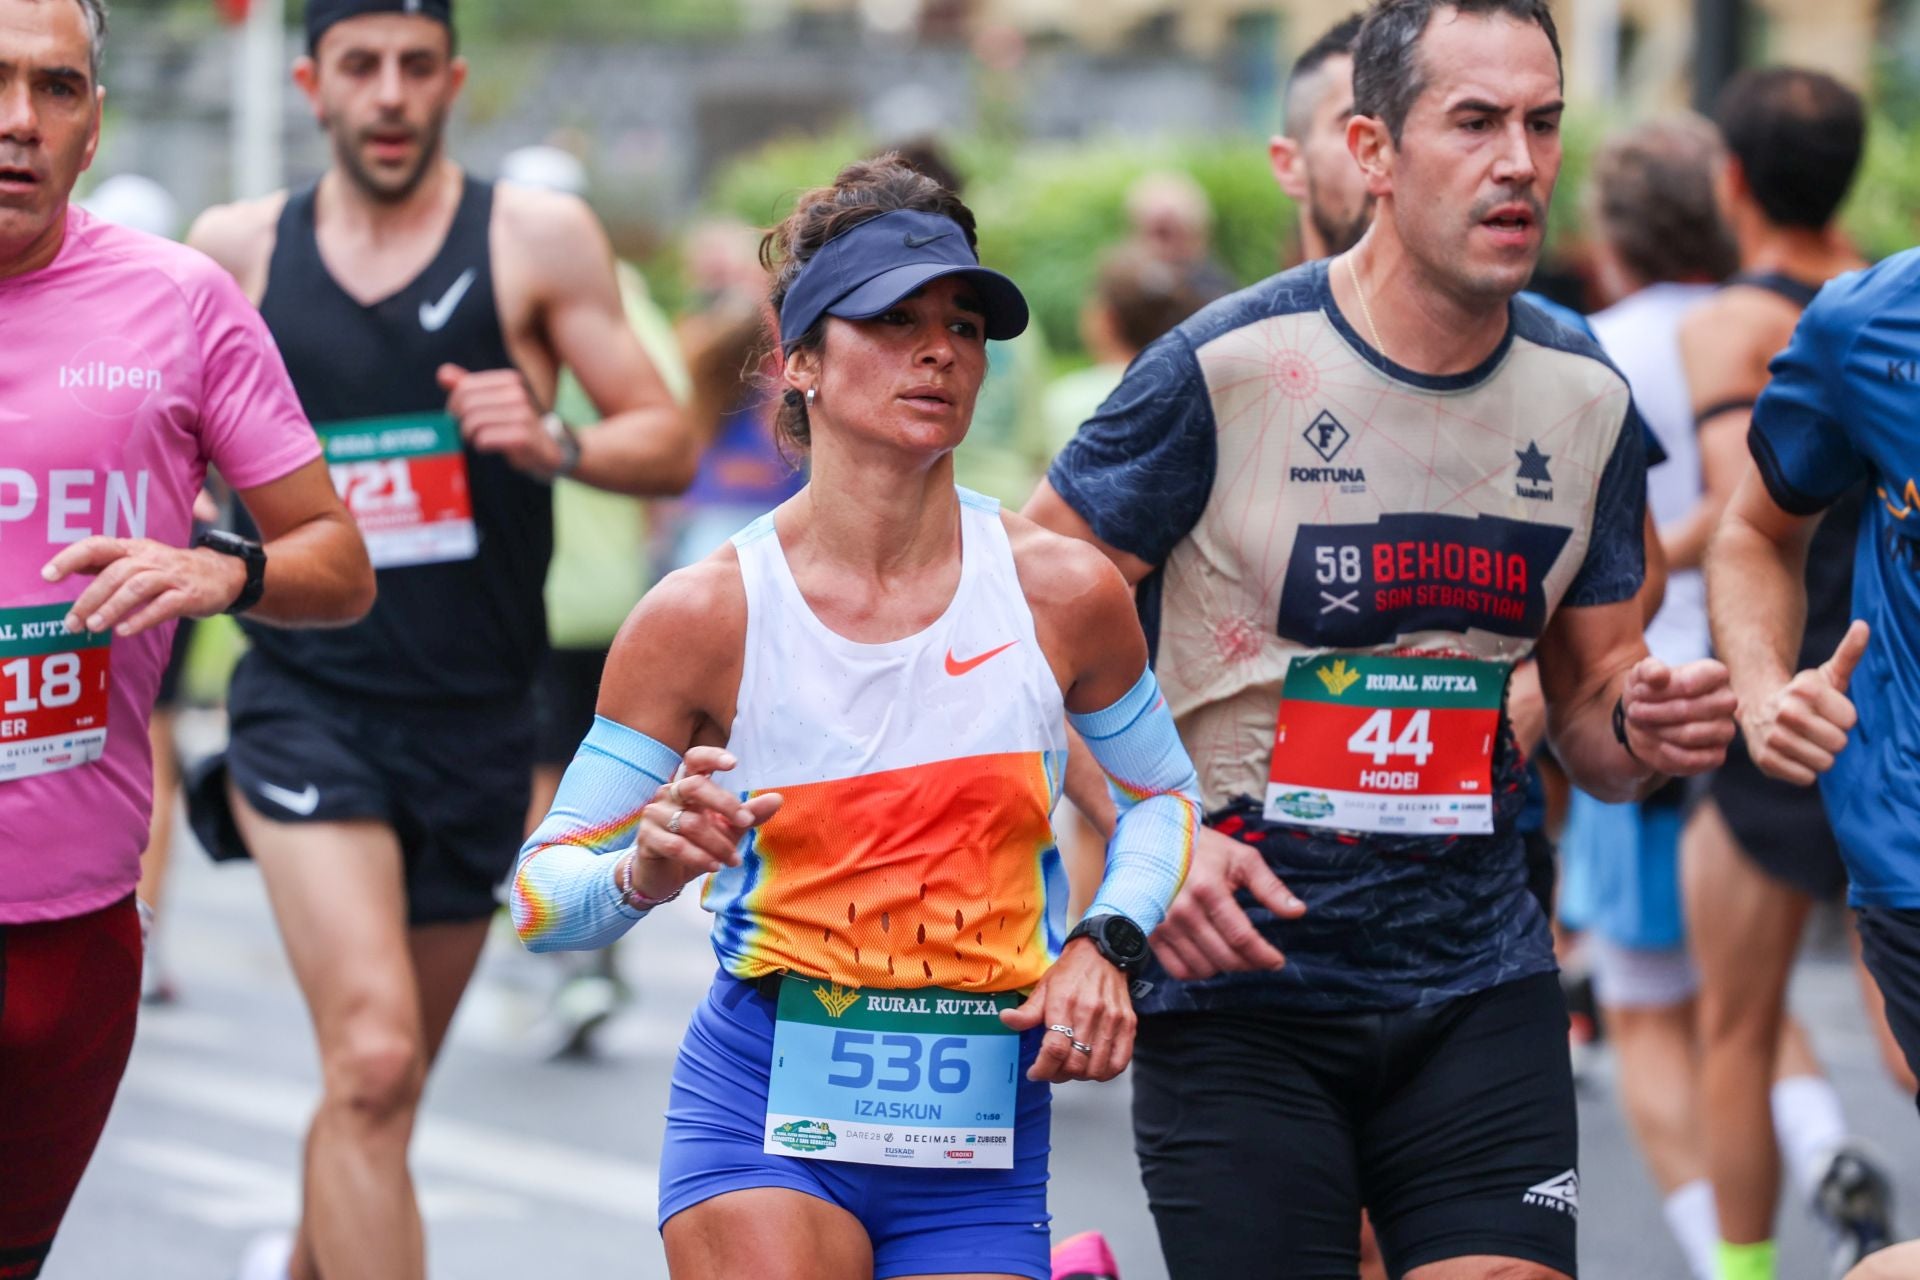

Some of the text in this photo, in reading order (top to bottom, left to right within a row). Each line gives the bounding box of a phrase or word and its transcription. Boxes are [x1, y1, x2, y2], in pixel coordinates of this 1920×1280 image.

[1290, 467, 1366, 483] FORTUNA
[0, 467, 149, 544] PEN
[1315, 546, 1362, 585] 58
[1372, 541, 1528, 595] BEHOBIA
[1375, 586, 1413, 612] SAN
[1366, 673, 1478, 692] RURAL KUTXA
[1347, 709, 1434, 766] 44
[1359, 770, 1419, 789] HODEI
[867, 995, 999, 1016] RURAL KUTXA
[828, 1030, 971, 1094] 536
[854, 1100, 942, 1120] IZASKUN
[905, 1134, 956, 1144] DECIMAS
[977, 1135, 1007, 1144] ZUBIEDER
[885, 1147, 914, 1155] EUSKADI
[1522, 1192, 1565, 1212] NIKE
